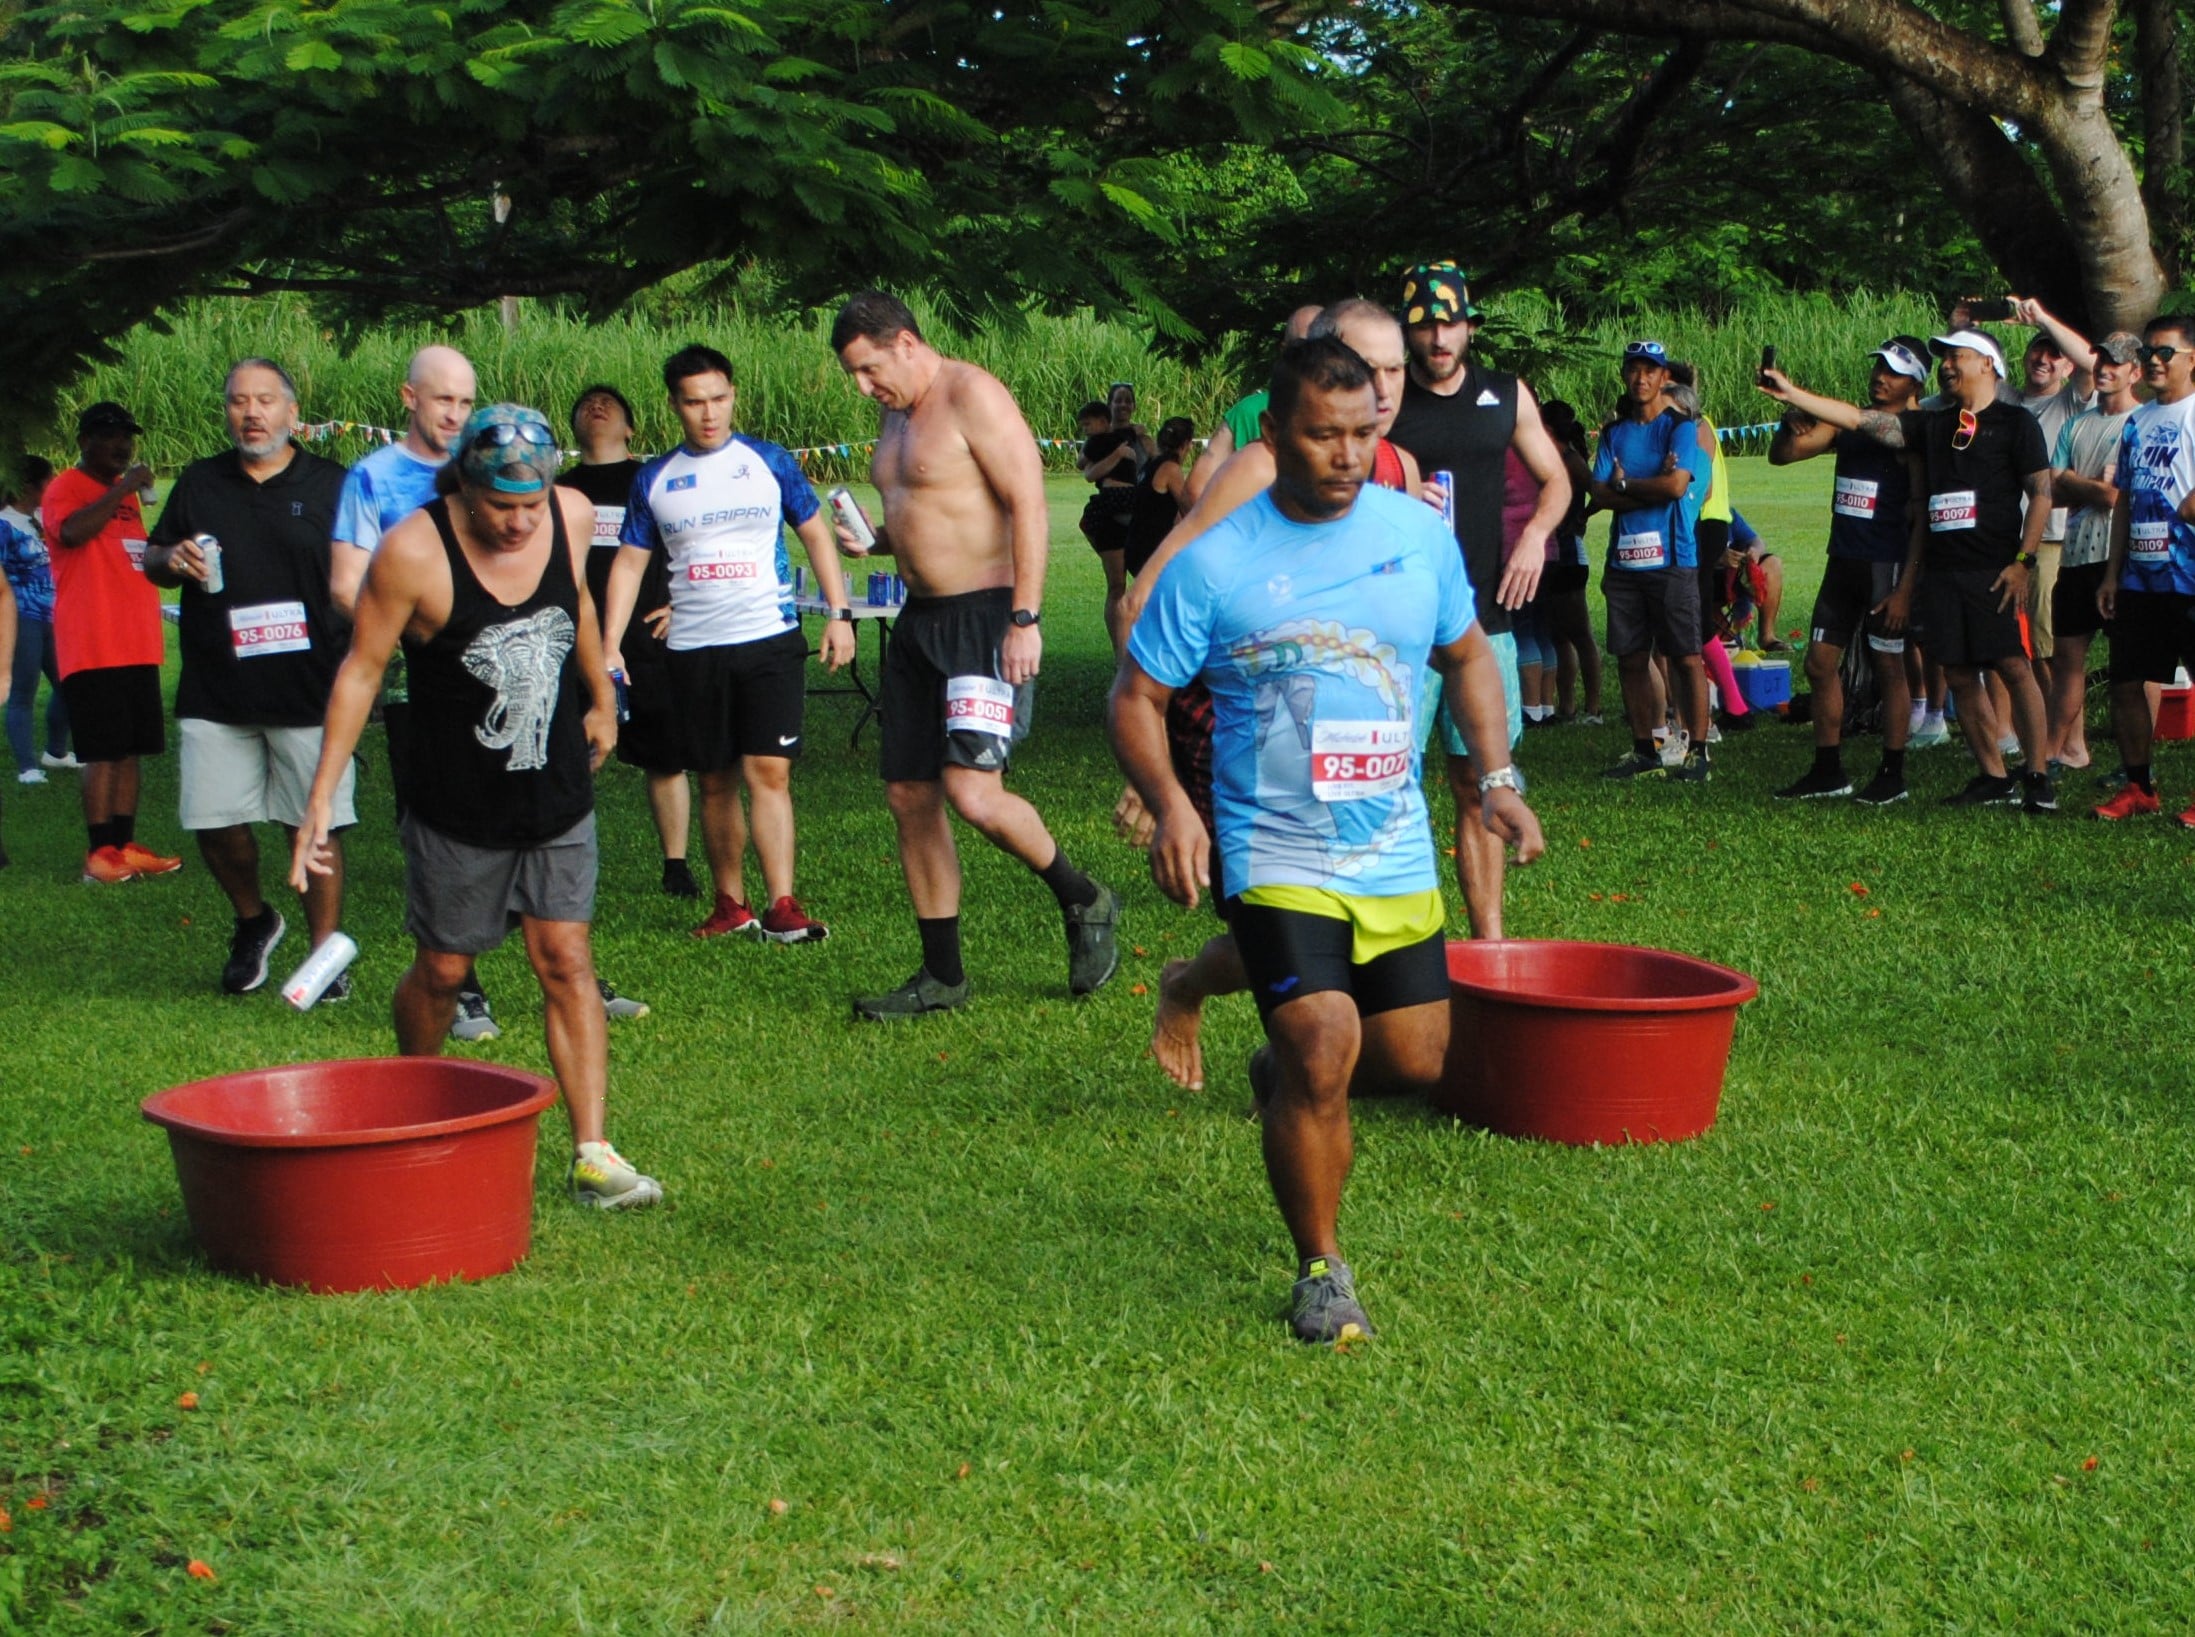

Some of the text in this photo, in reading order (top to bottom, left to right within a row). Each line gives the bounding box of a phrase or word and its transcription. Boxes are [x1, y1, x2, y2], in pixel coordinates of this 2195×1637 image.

[664, 506, 772, 534] RUN SAIPAN
[1930, 507, 1970, 522] 95-0097
[1620, 547, 1658, 559] 95-0102
[692, 564, 752, 579] 95-0093
[239, 623, 303, 645] 95-0076
[950, 699, 1007, 722] 95-0051
